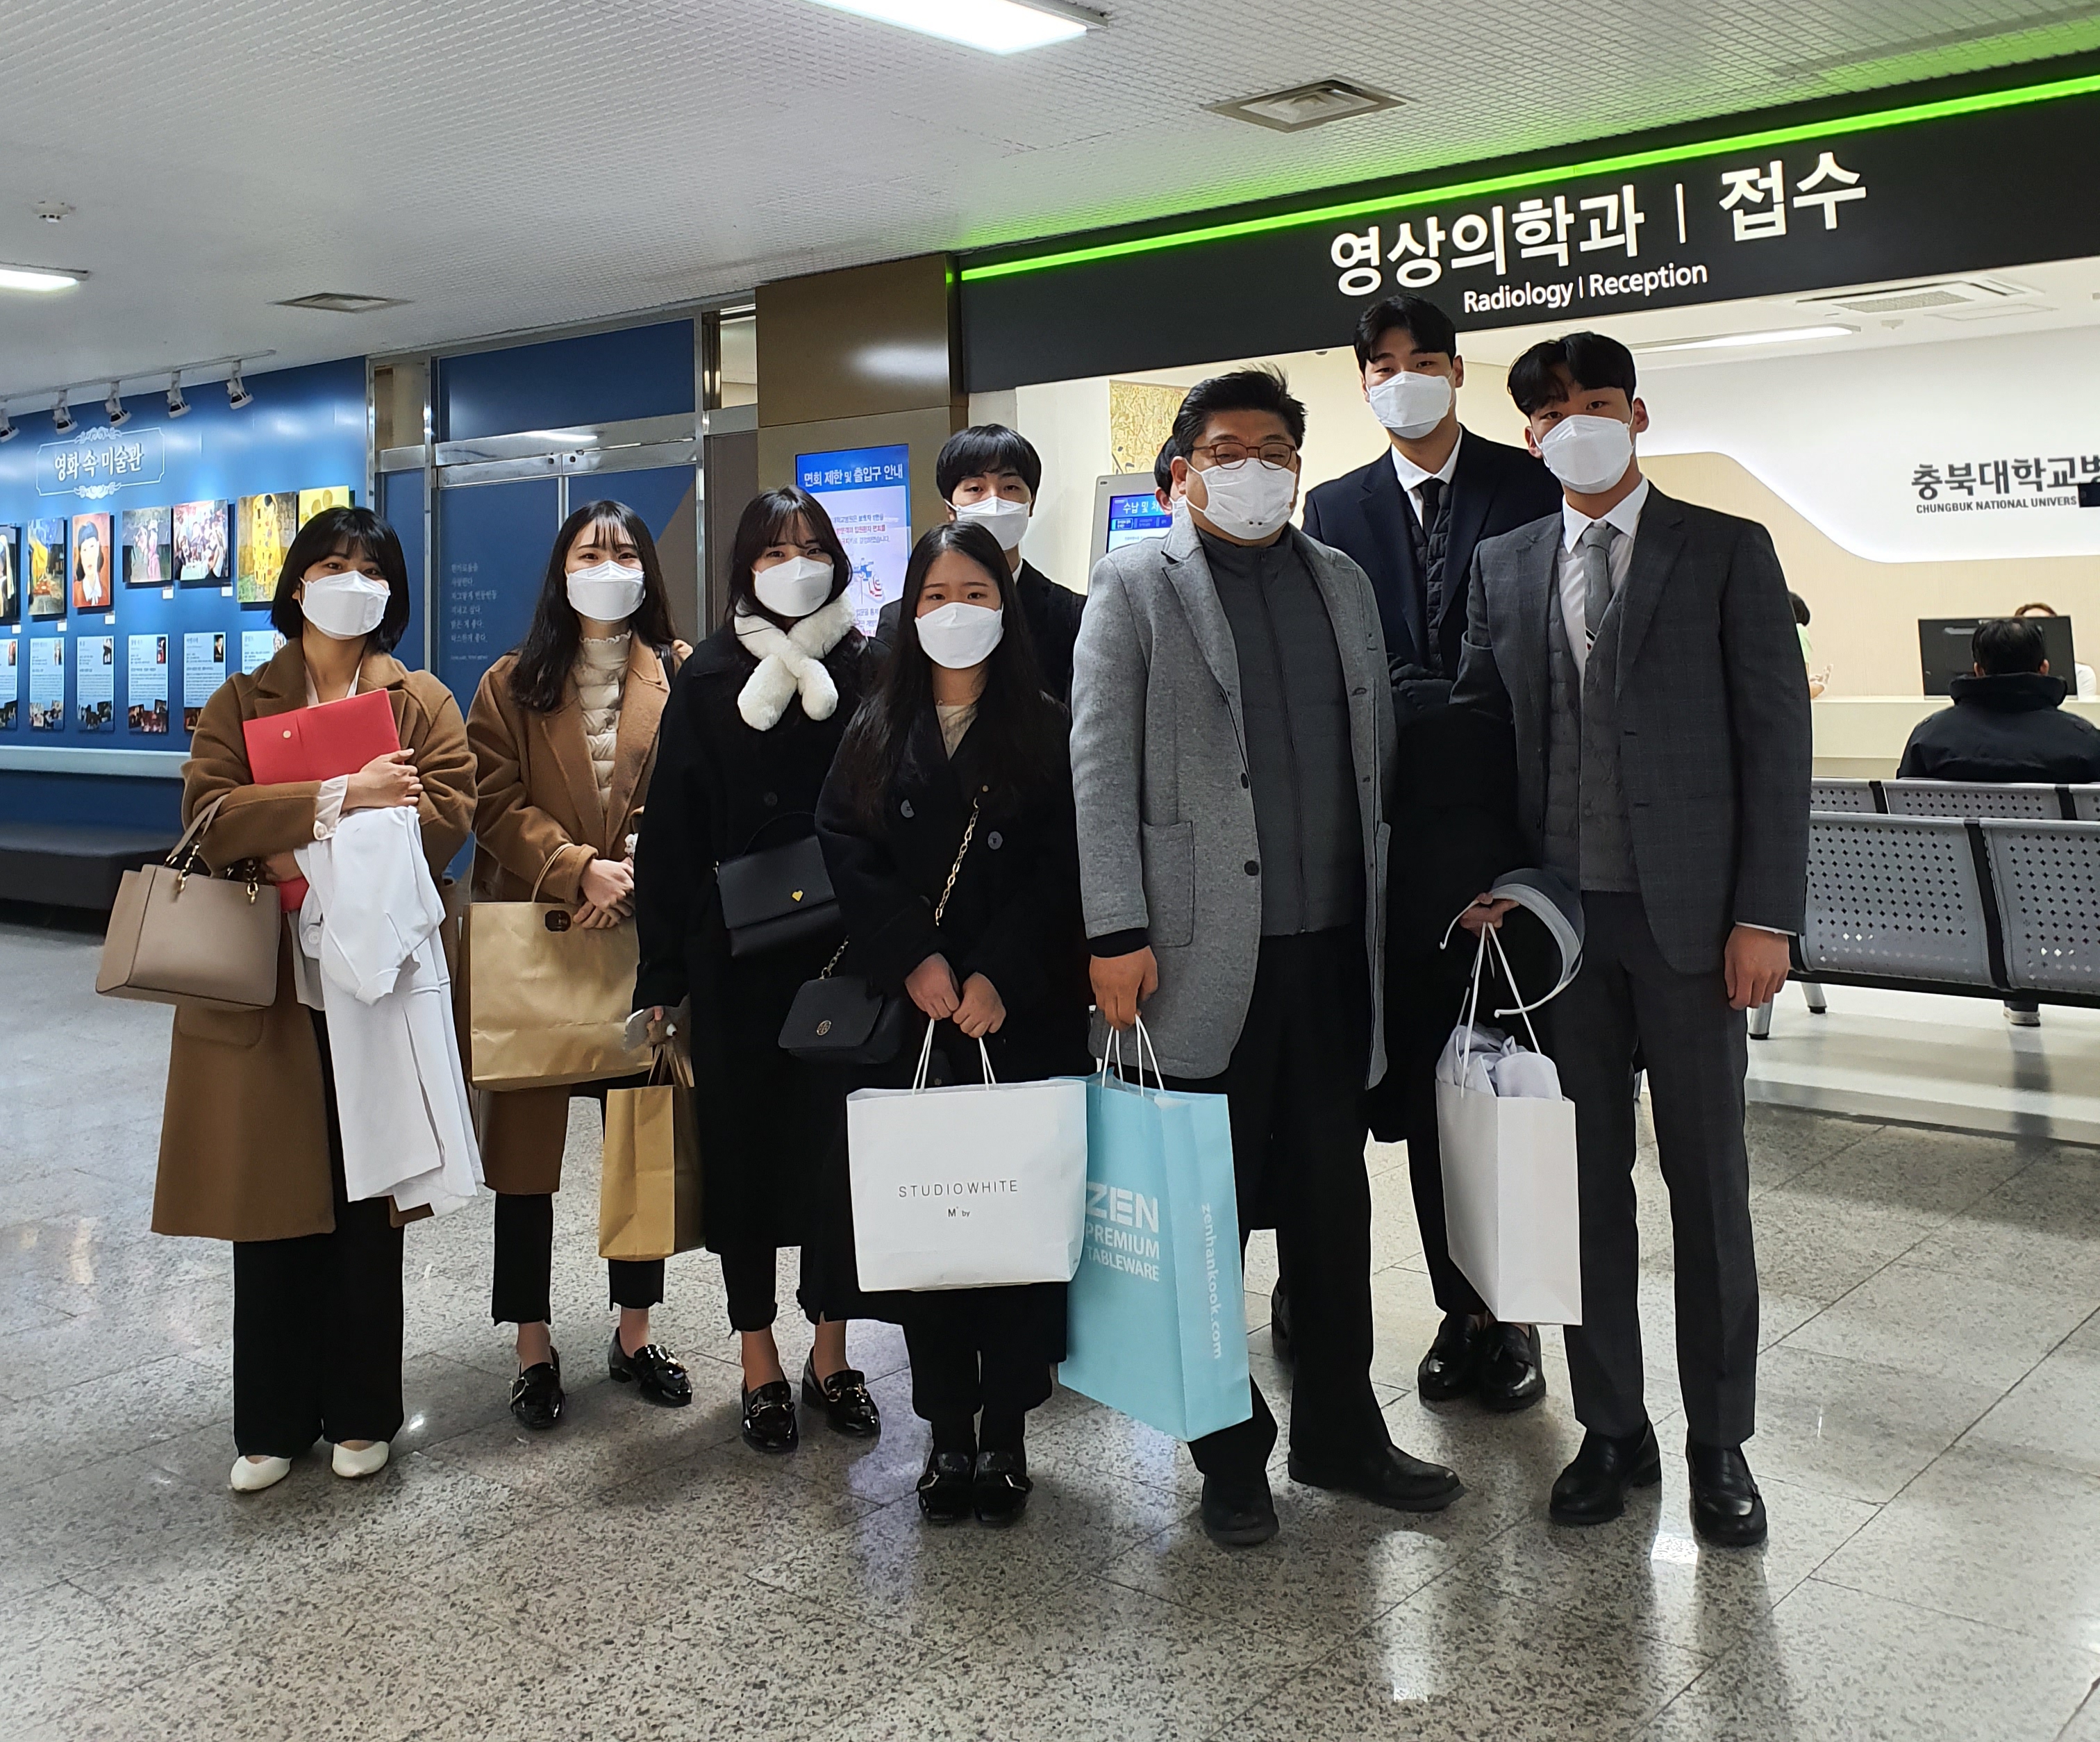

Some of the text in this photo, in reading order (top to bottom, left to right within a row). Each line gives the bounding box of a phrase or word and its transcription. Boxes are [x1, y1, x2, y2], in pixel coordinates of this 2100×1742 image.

[1331, 151, 1867, 297] 영상의학과 접수
[1463, 263, 1708, 313] Radiology Reception
[54, 442, 144, 482] 영화 속 미술관
[804, 463, 903, 487] 면회 제한 및 출입구 안내
[1123, 501, 1139, 515] 수납
[1141, 501, 1149, 513] 및
[1916, 495, 2077, 514] CHUNGBUK NATIONAL UNIVERS
[899, 1180, 1018, 1197] STUDIOWHITE
[1086, 1181, 1159, 1234] ZEN
[1085, 1221, 1160, 1261] PREMIUM
[1085, 1245, 1159, 1282] TABLEWARE
[1202, 1202, 1222, 1359] zenhankook.com
